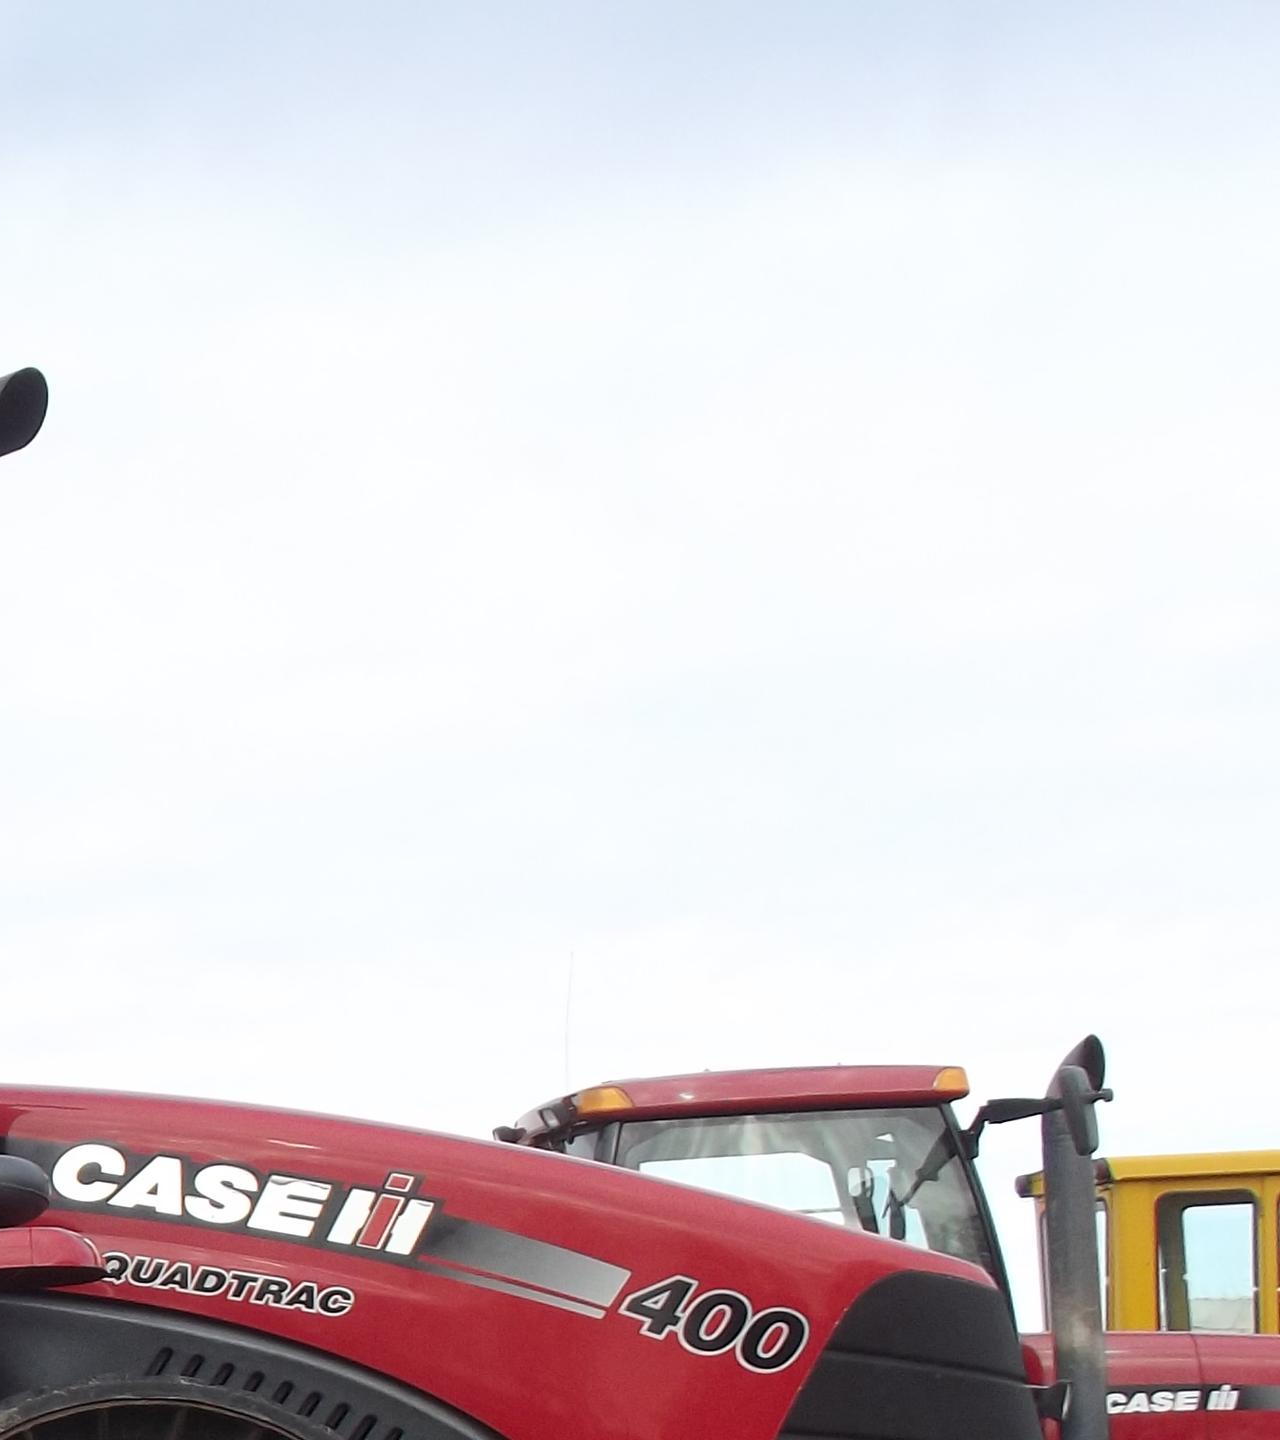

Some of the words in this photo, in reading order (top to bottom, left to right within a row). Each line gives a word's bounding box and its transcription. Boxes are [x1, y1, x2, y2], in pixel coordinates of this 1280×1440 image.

[51, 1143, 332, 1238] CASE
[101, 1252, 354, 1317] QUADTRAC
[617, 1274, 810, 1375] 400
[1106, 1389, 1201, 1415] CASE
